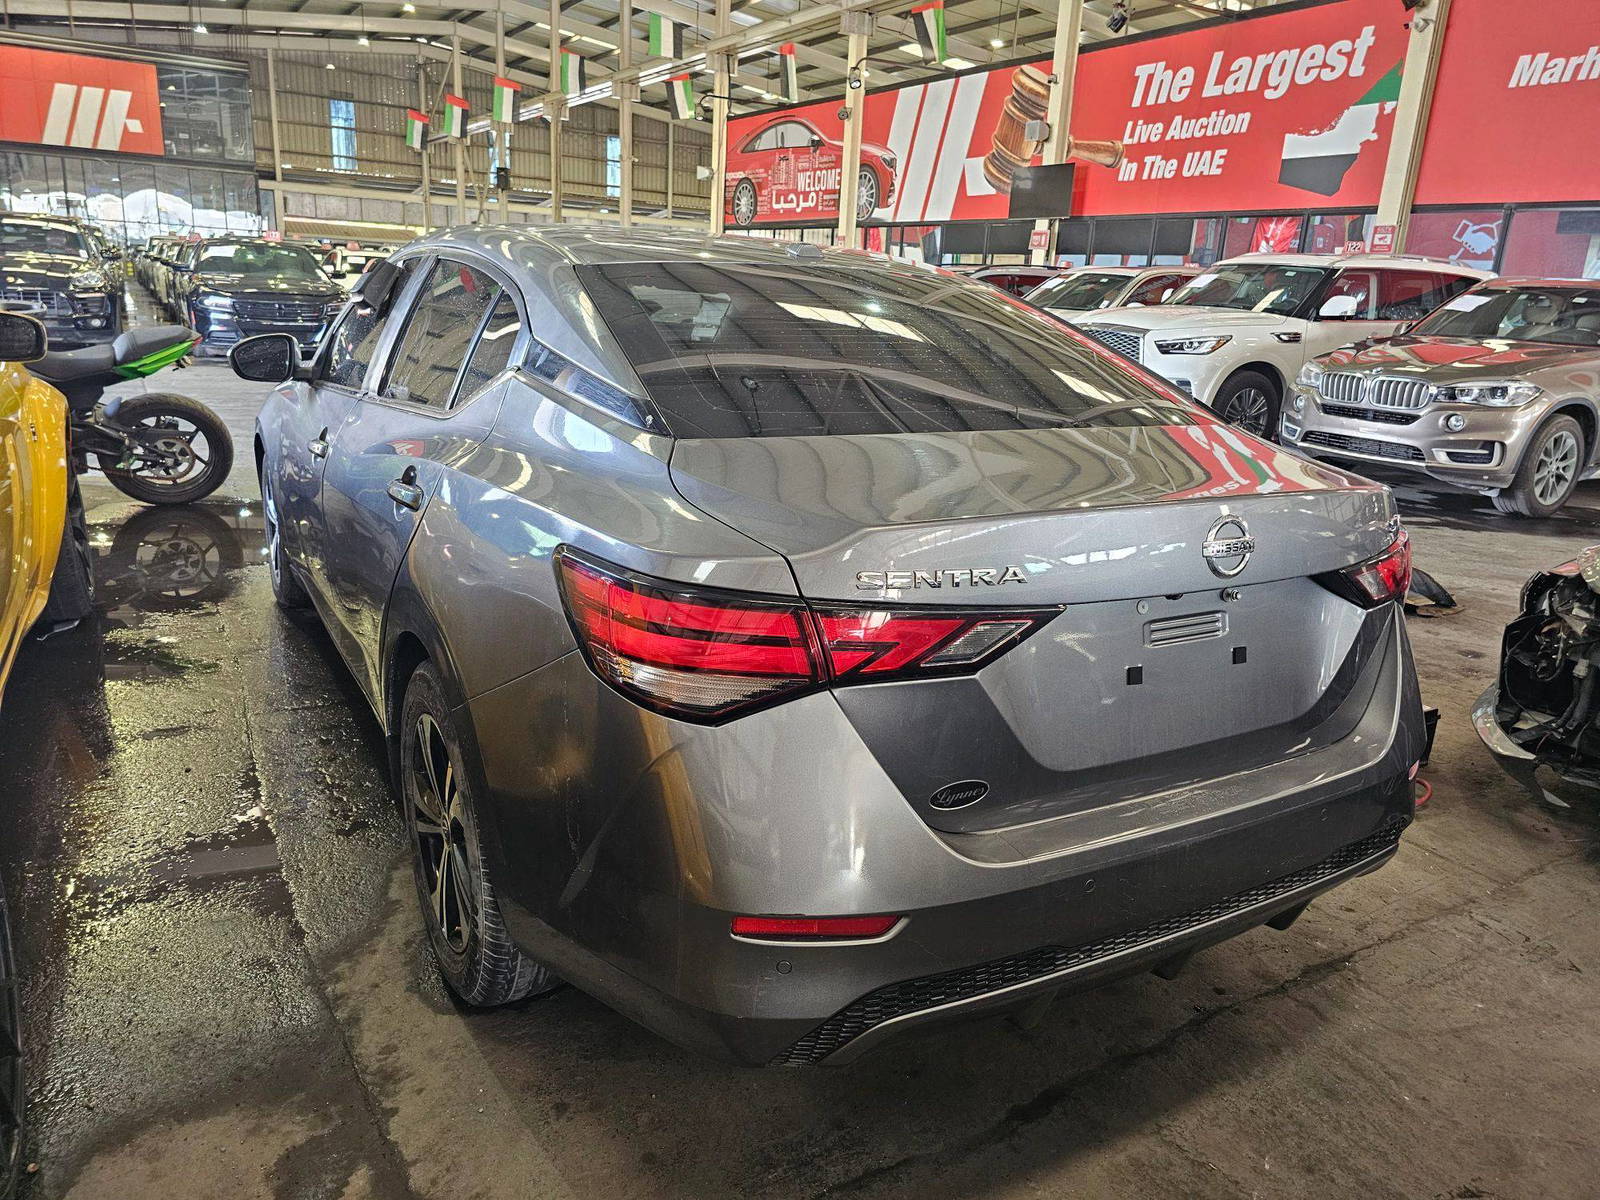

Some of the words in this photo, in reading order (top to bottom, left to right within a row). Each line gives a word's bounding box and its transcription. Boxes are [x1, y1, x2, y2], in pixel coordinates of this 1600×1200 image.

[1131, 61, 1195, 108] The
[1201, 24, 1376, 100] Largest
[1122, 119, 1169, 146] Live
[1165, 109, 1252, 142] Auction
[1117, 158, 1138, 182] In
[1141, 154, 1183, 180] The
[1182, 148, 1229, 177] UAE
[797, 167, 841, 193] WELCOME
[771, 189, 817, 214] مرحبا
[1210, 539, 1255, 555] NISSAN
[855, 565, 1028, 591] SENTRA
